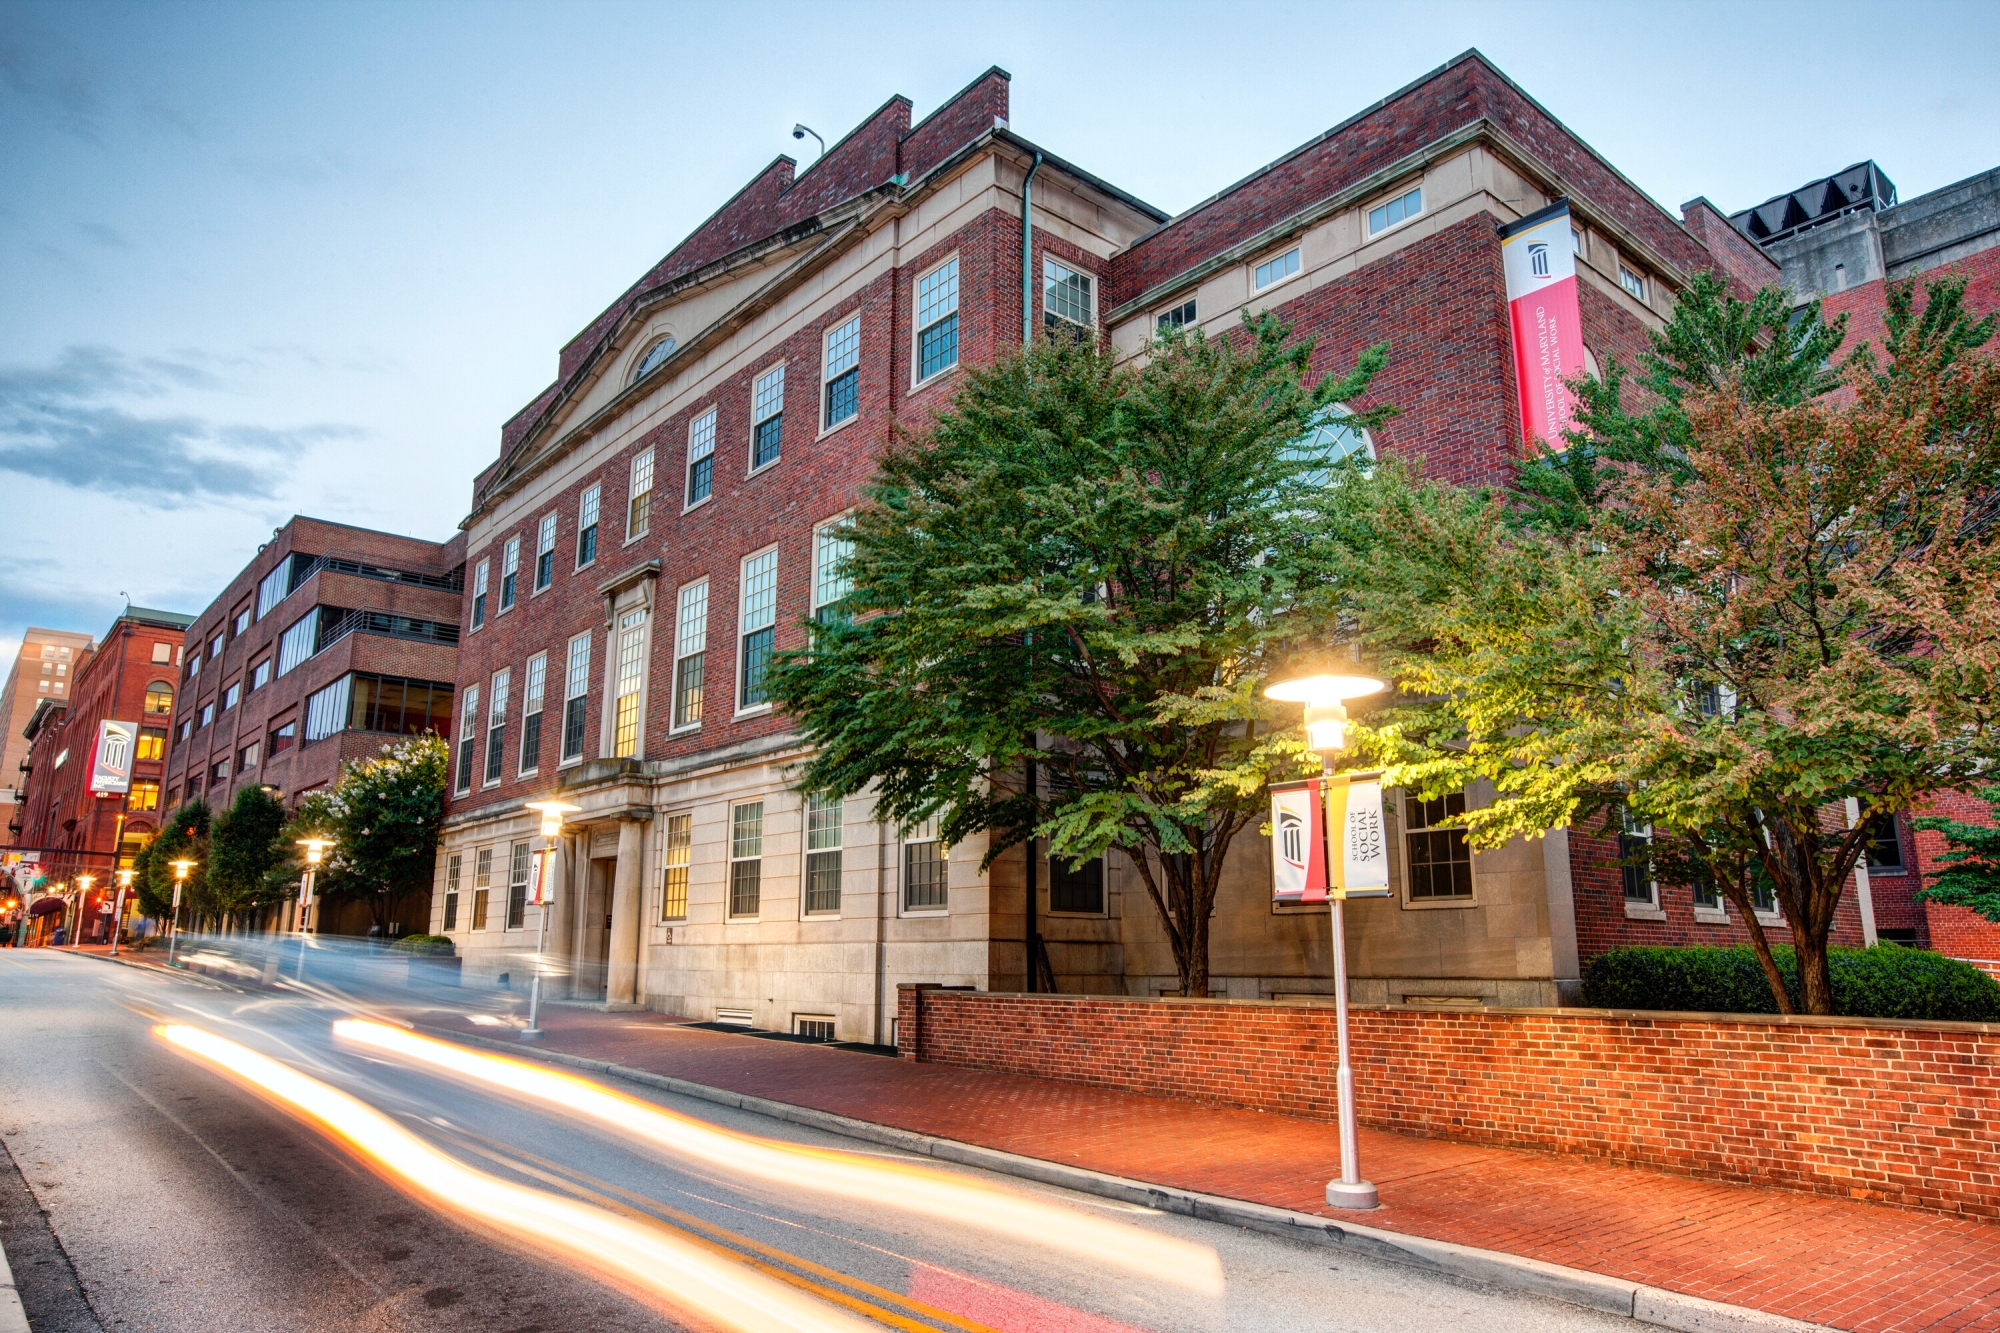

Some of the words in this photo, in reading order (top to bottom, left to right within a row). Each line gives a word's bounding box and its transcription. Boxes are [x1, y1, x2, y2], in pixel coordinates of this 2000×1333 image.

[1536, 306, 1550, 366] MARYLAND
[1549, 316, 1558, 347] WORK
[1543, 376, 1558, 440] UNIVERSITY
[1557, 396, 1568, 432] CHOOL
[1350, 811, 1356, 823] OF
[1357, 807, 1370, 861] SOCIAL
[1368, 809, 1381, 859] WORK
[1350, 825, 1358, 861] SCHOOL
